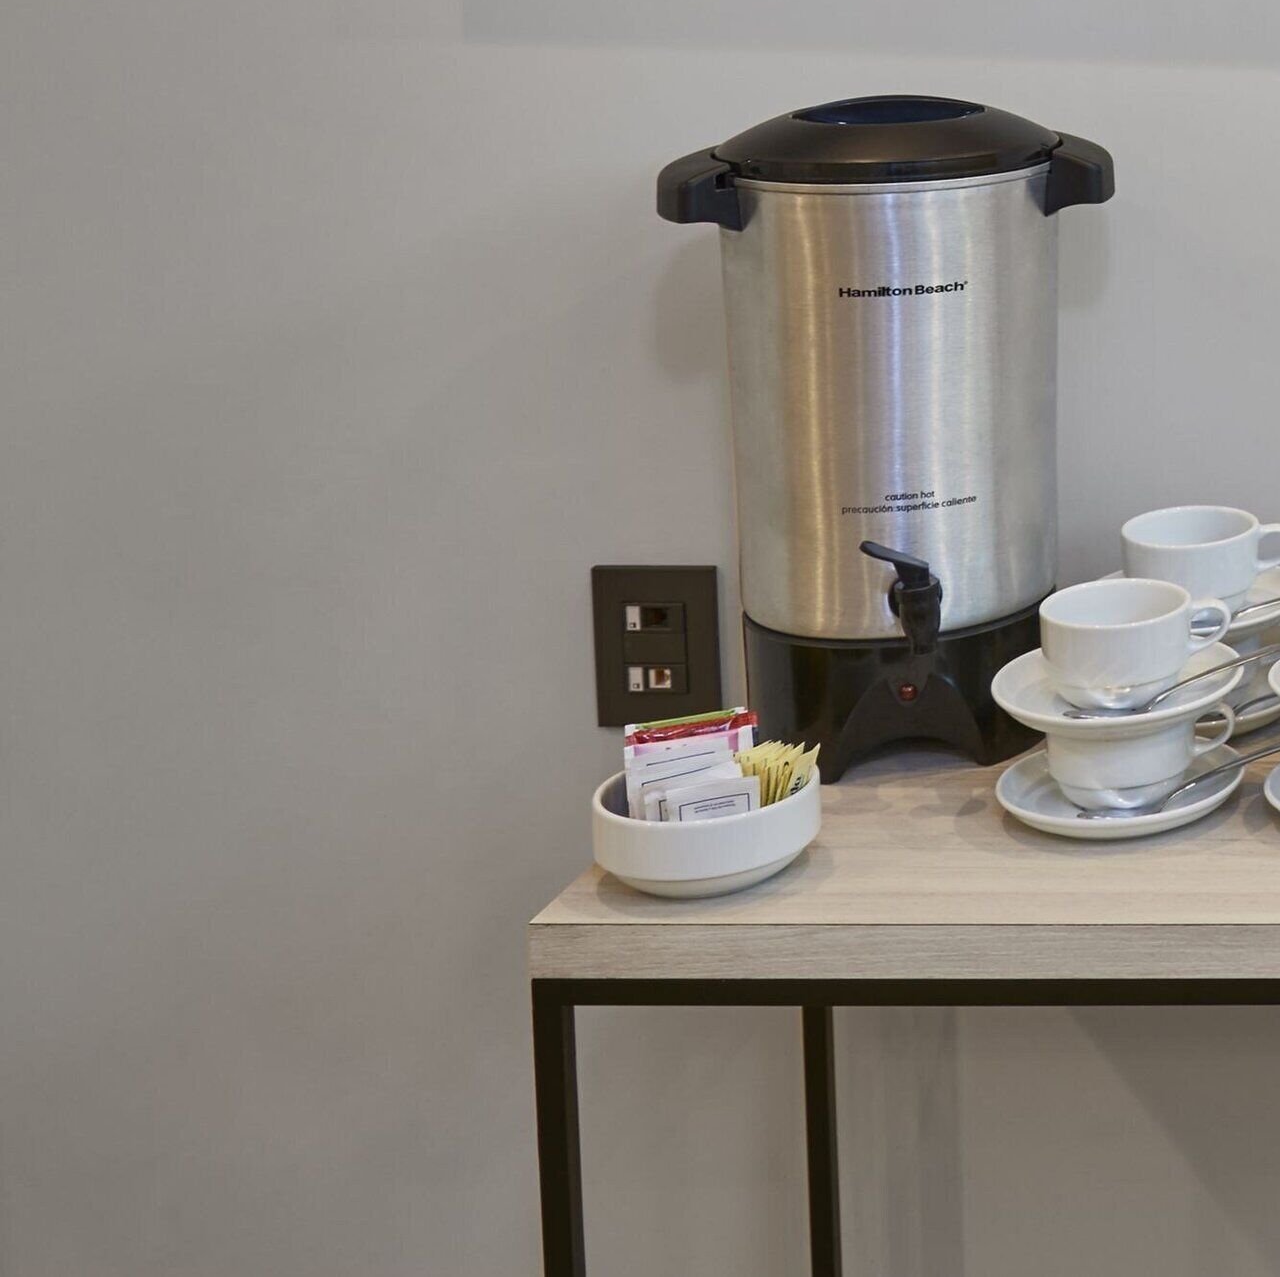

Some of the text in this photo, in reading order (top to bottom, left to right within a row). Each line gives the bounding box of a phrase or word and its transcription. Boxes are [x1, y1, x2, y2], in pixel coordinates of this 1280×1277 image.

[838, 286, 912, 298] Hamilton
[885, 491, 935, 502] caution hot
[841, 495, 977, 515] precaución superficie caliente
